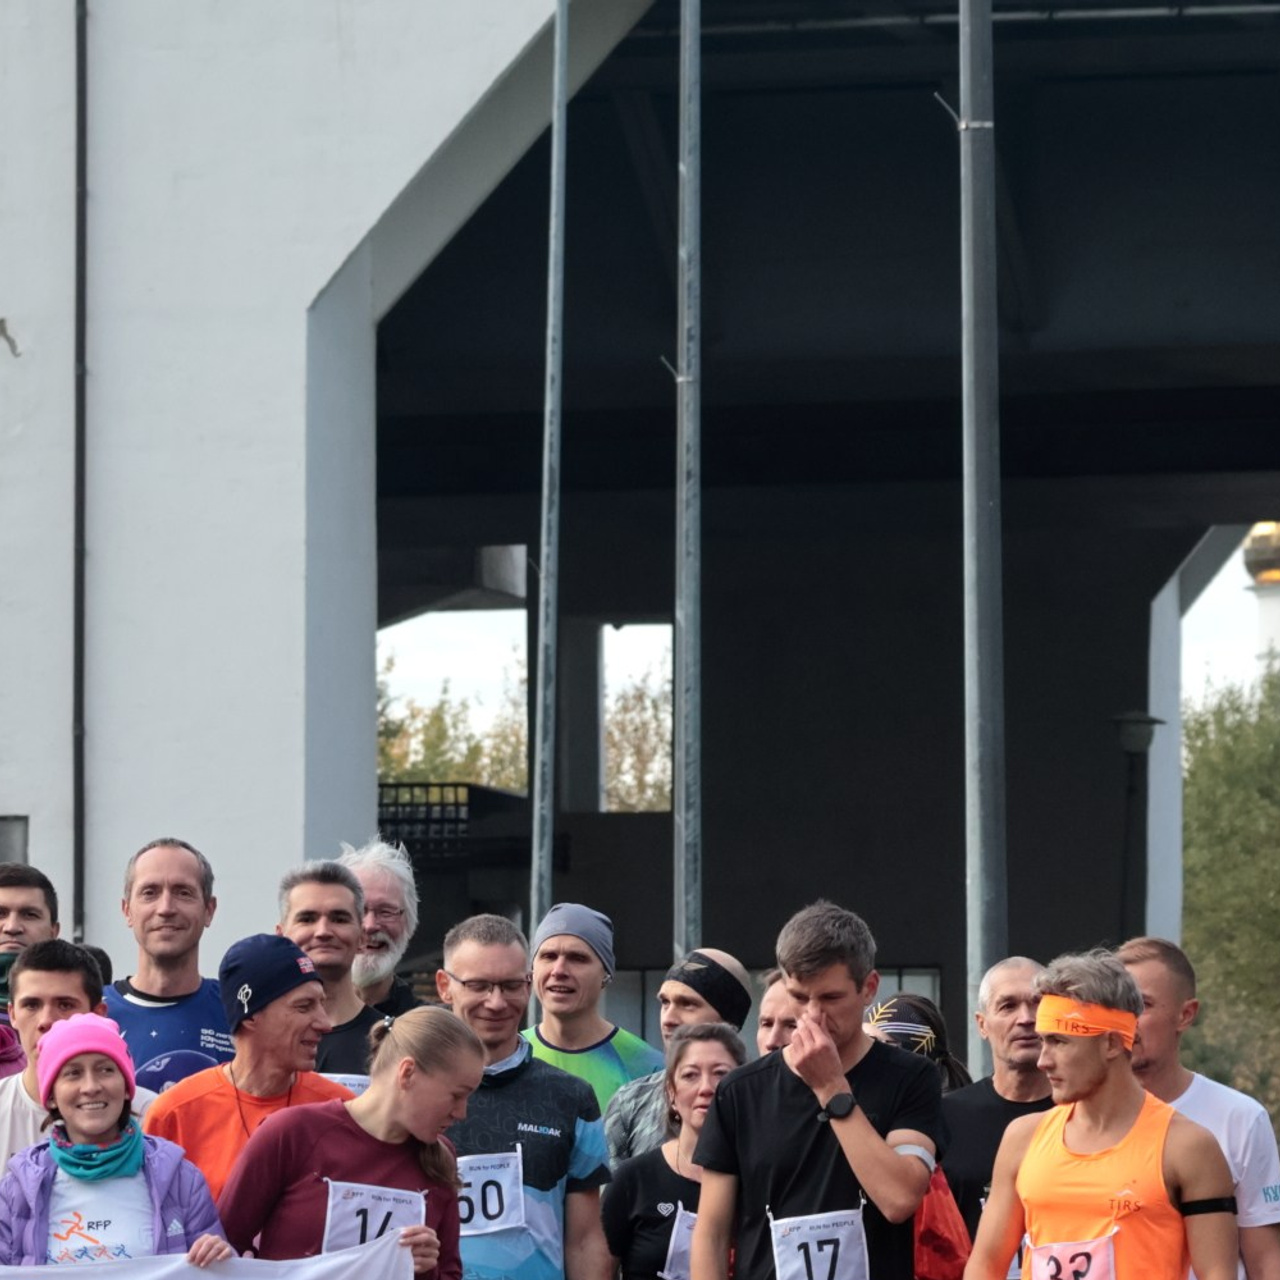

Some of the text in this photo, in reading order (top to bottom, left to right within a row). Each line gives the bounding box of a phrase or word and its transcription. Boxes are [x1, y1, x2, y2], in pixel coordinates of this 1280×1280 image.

[1055, 1018, 1090, 1034] TIRS
[1109, 1199, 1141, 1212] TIRS
[87, 1220, 112, 1231] RFP
